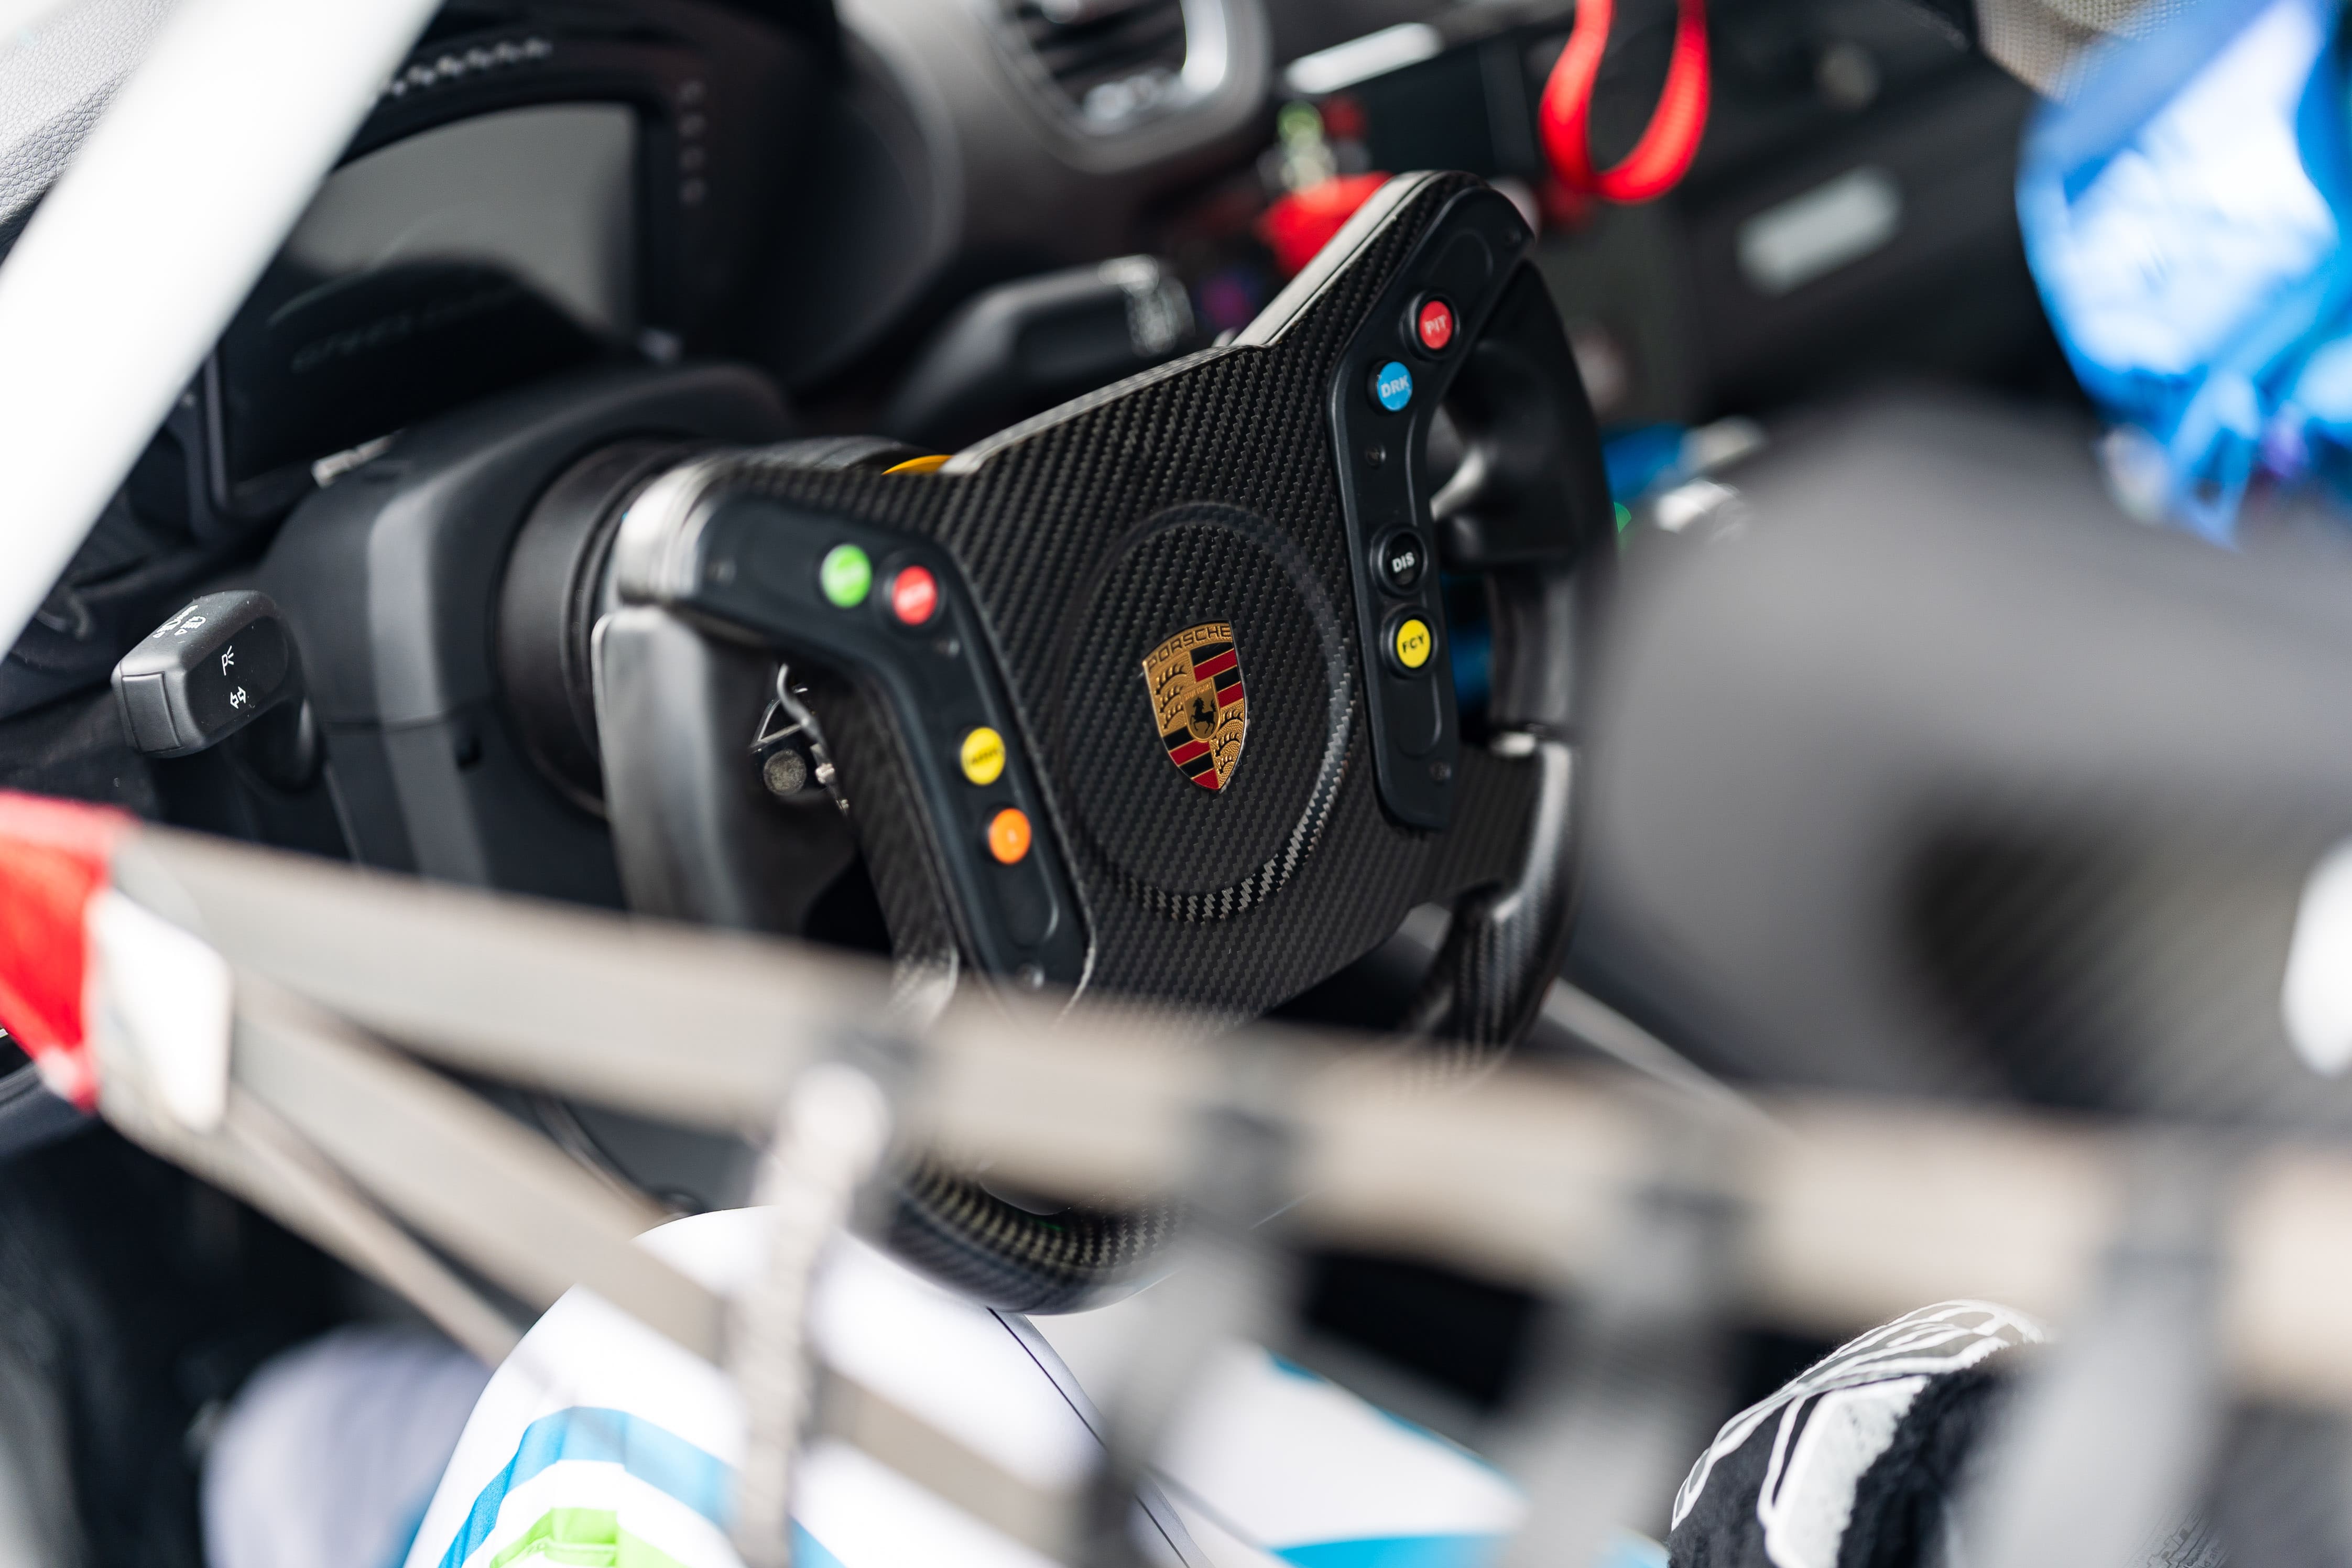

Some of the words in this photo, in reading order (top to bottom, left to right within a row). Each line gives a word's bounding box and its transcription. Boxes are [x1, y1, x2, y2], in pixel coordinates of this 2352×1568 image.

[1424, 315, 1447, 336] PIT
[1380, 375, 1409, 398] DRK
[1392, 552, 1415, 573] DIS
[1147, 626, 1232, 672] PORSCHE
[1401, 633, 1425, 653] FCY
